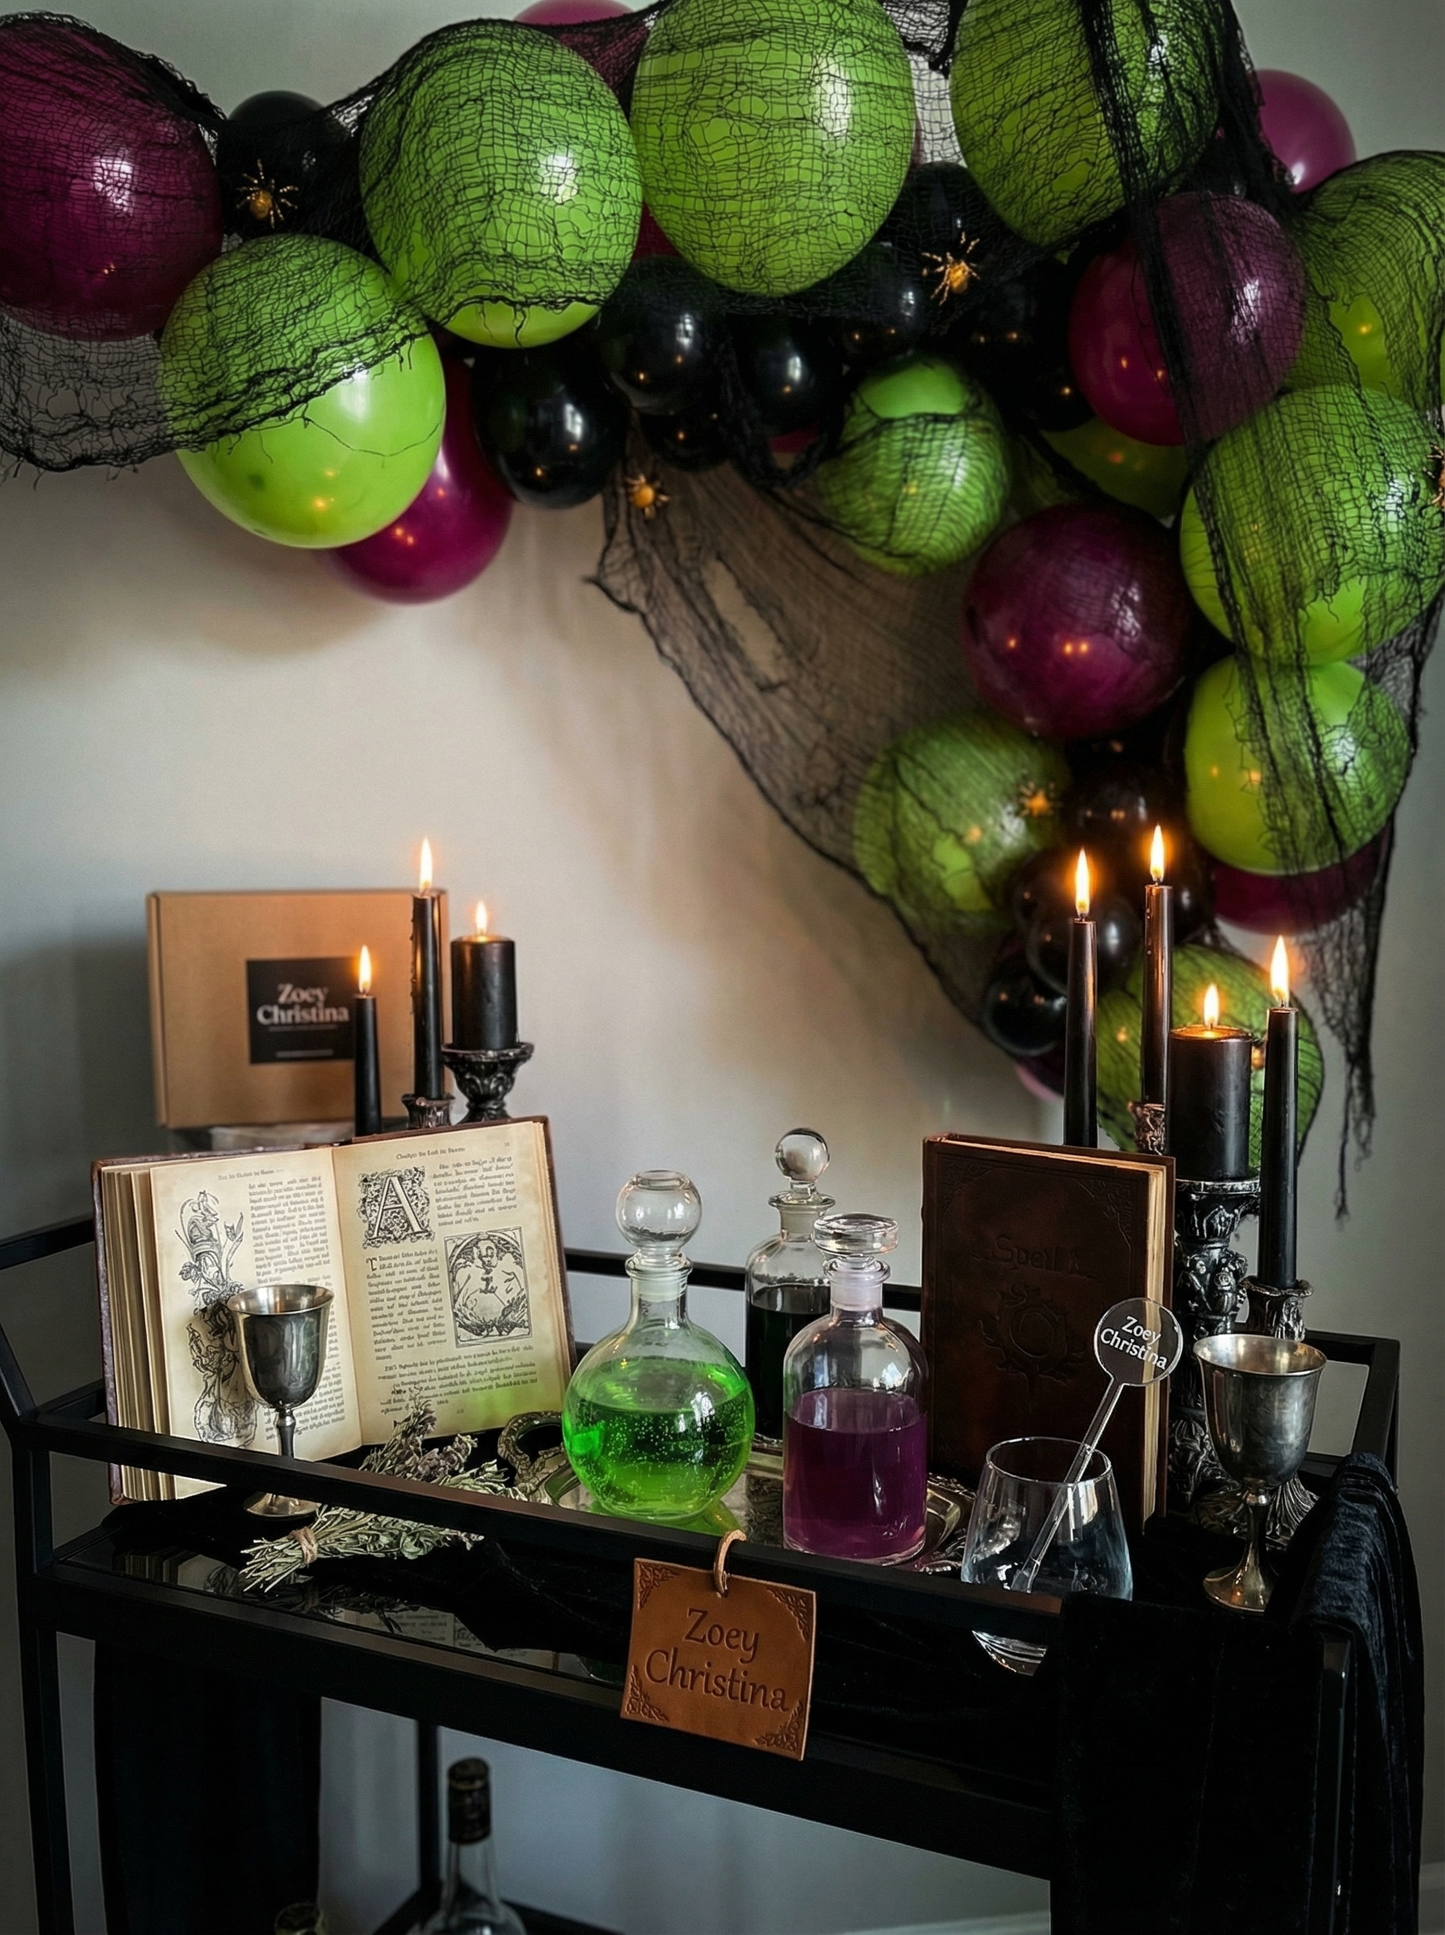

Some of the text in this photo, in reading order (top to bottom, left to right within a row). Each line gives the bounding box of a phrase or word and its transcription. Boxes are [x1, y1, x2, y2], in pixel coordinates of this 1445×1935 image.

[277, 983, 329, 1007] Zoey
[256, 1004, 350, 1025] Christina
[1121, 1315, 1162, 1346] Zoey
[1100, 1328, 1168, 1370] Christina
[684, 1607, 760, 1665] Zoey
[645, 1647, 790, 1712] Christina
